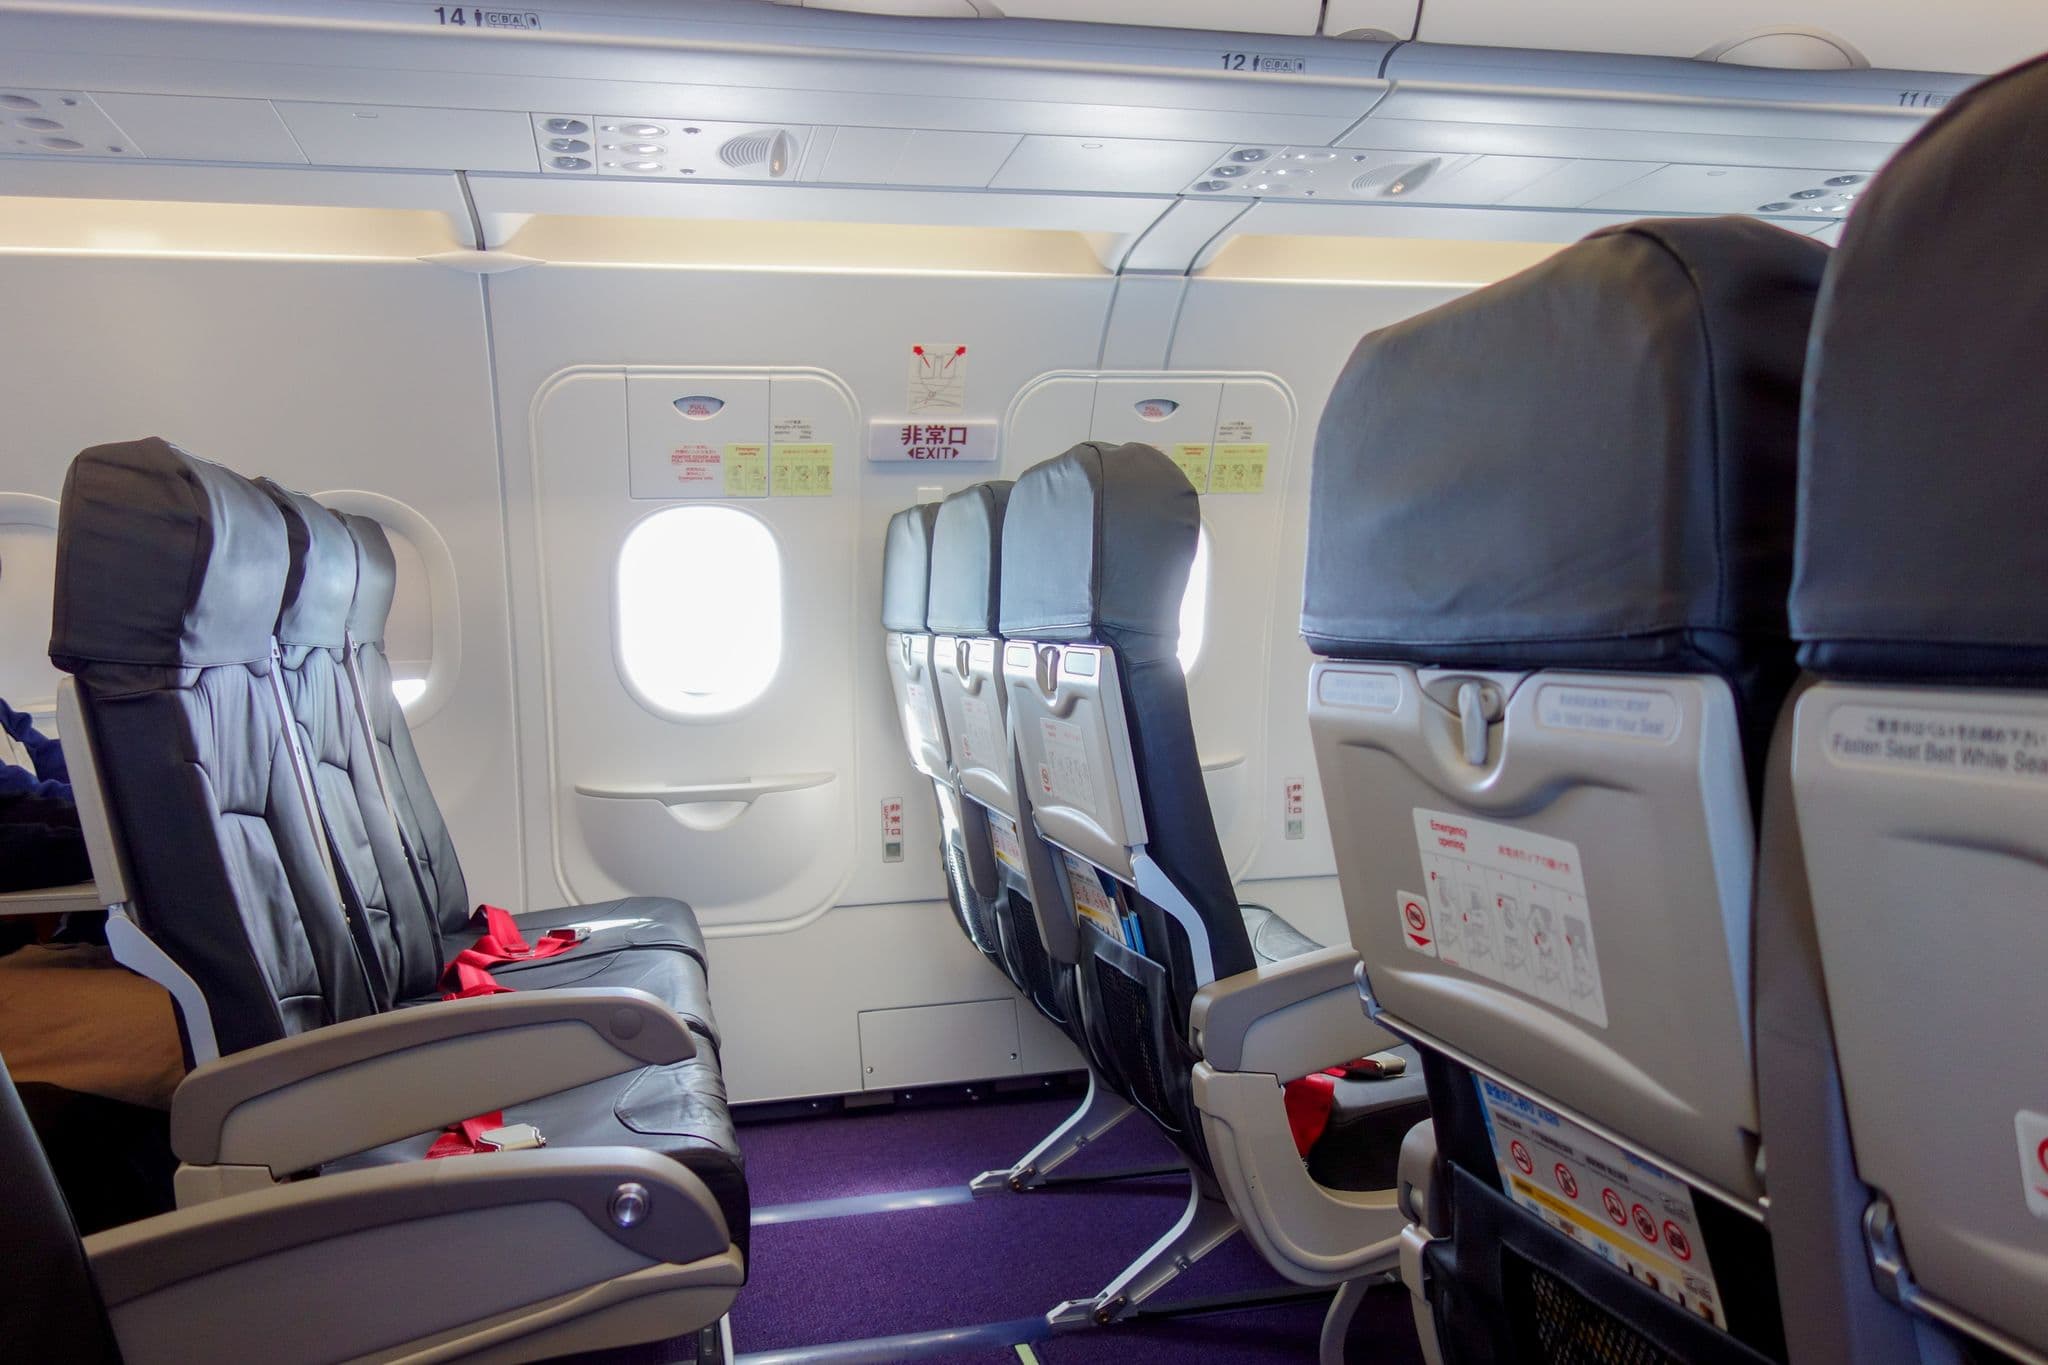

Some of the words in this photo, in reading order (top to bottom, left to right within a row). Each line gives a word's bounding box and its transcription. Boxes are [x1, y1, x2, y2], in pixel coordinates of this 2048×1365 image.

[434, 6, 466, 26] 14
[1221, 53, 1247, 71] 12
[1899, 91, 1920, 107] 11
[901, 424, 968, 446] 非常口
[915, 446, 952, 460] EXIT
[1885, 737, 1921, 760] Seat
[1924, 740, 1956, 763] Belt
[1961, 745, 2009, 770] While
[890, 803, 901, 836] 非常口
[1430, 819, 1468, 839] Emergency
